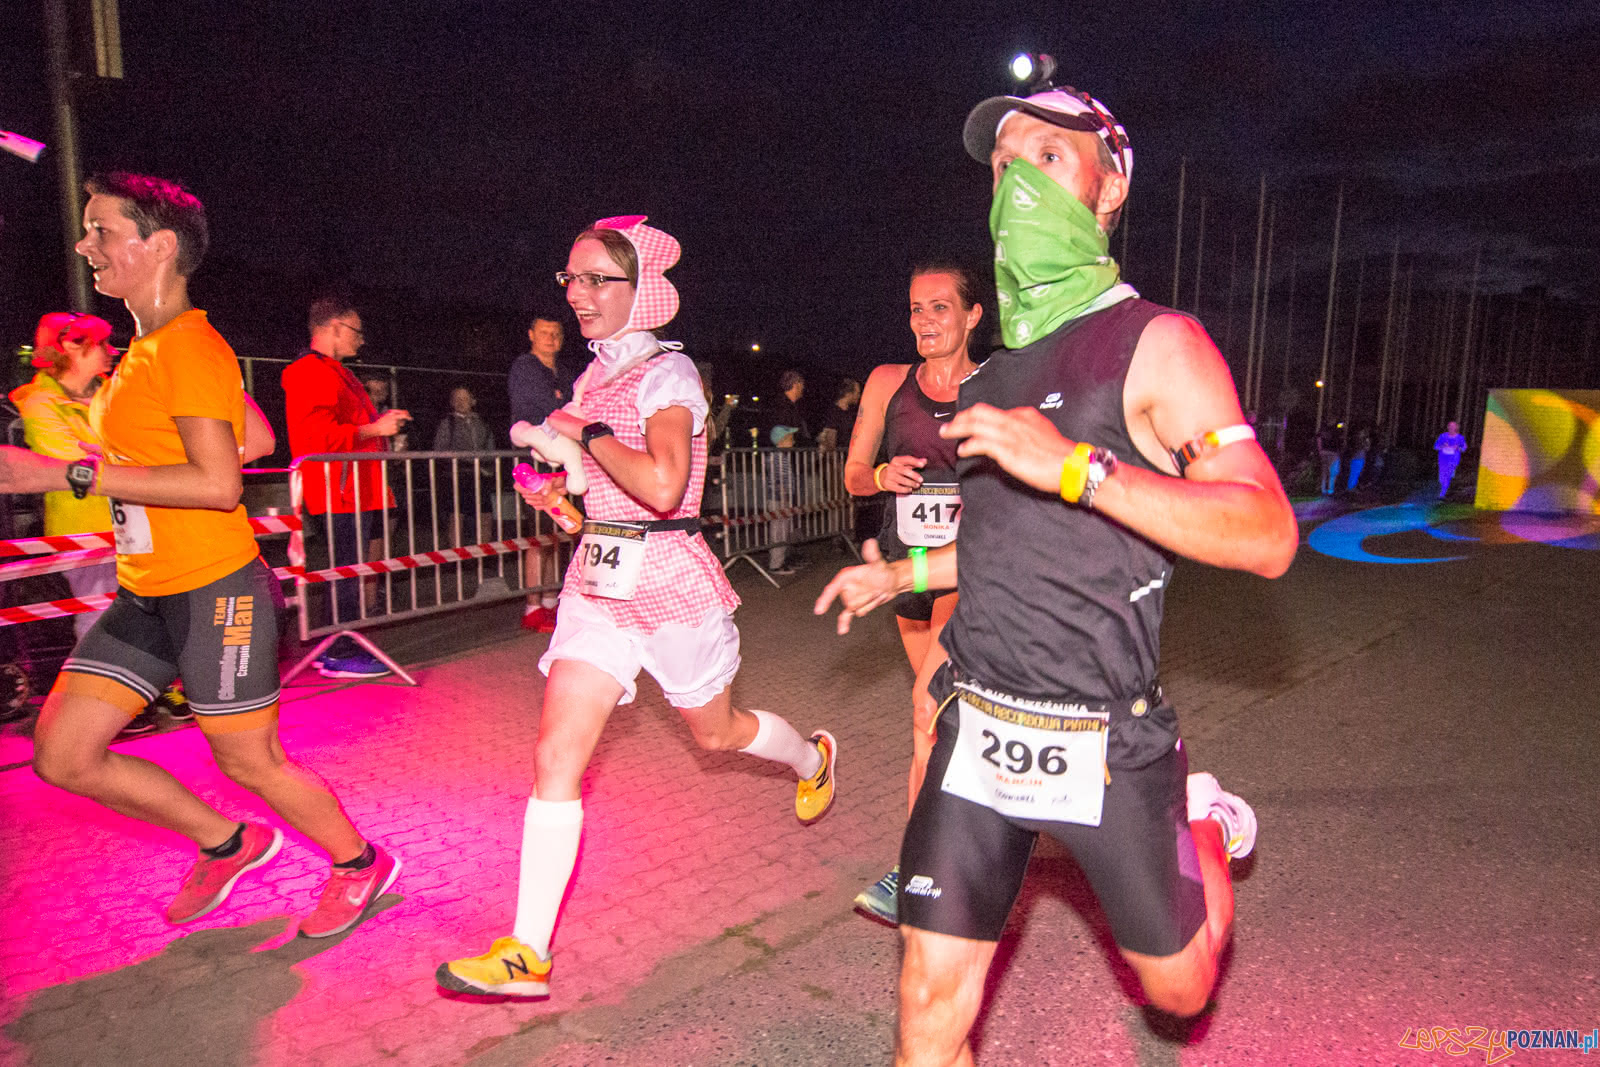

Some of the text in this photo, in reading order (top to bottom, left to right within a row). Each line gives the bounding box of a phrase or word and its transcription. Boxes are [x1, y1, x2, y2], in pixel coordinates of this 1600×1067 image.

[911, 502, 962, 523] 417
[583, 543, 621, 570] 794
[213, 597, 227, 626] TEAM
[981, 729, 1068, 776] 296
